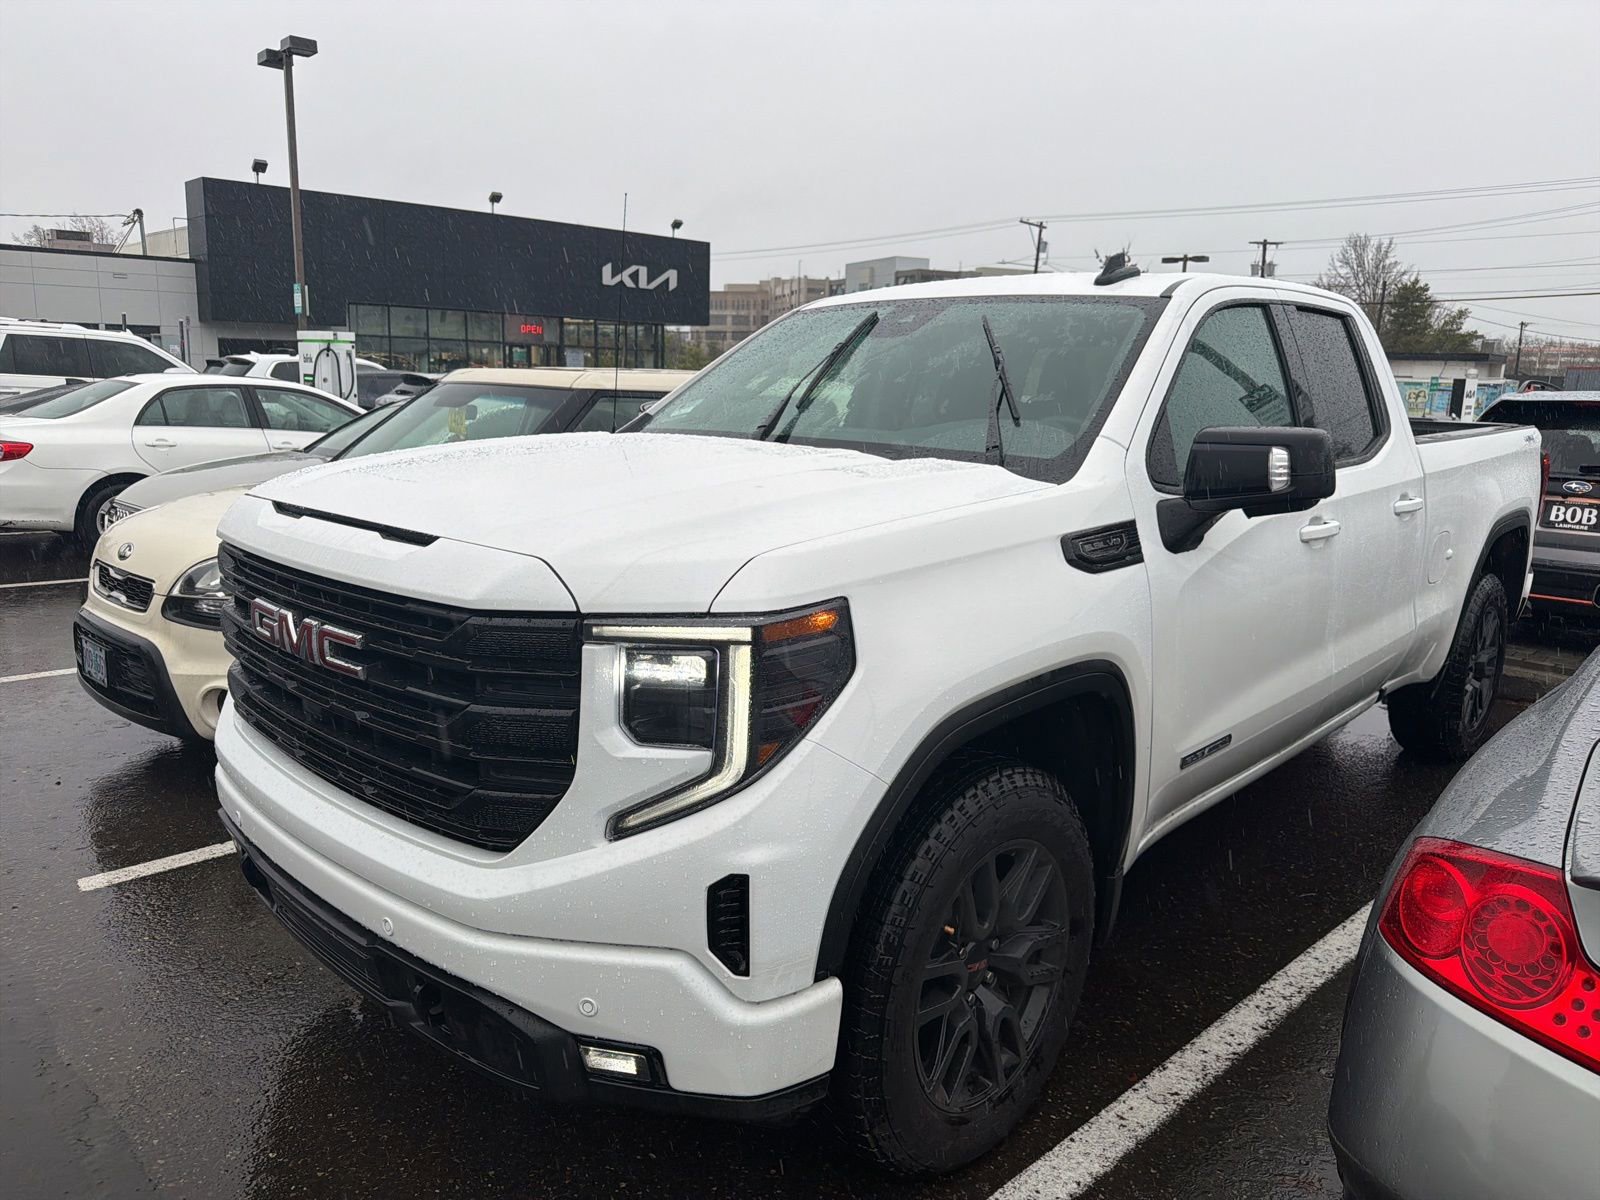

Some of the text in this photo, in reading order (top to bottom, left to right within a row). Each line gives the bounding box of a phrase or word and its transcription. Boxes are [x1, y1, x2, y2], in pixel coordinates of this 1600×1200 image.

[602, 262, 678, 291] KIA
[520, 324, 543, 335] OPEN
[1550, 505, 1598, 525] BOB
[1555, 523, 1589, 531] LANPHERE
[251, 598, 367, 680] GMC
